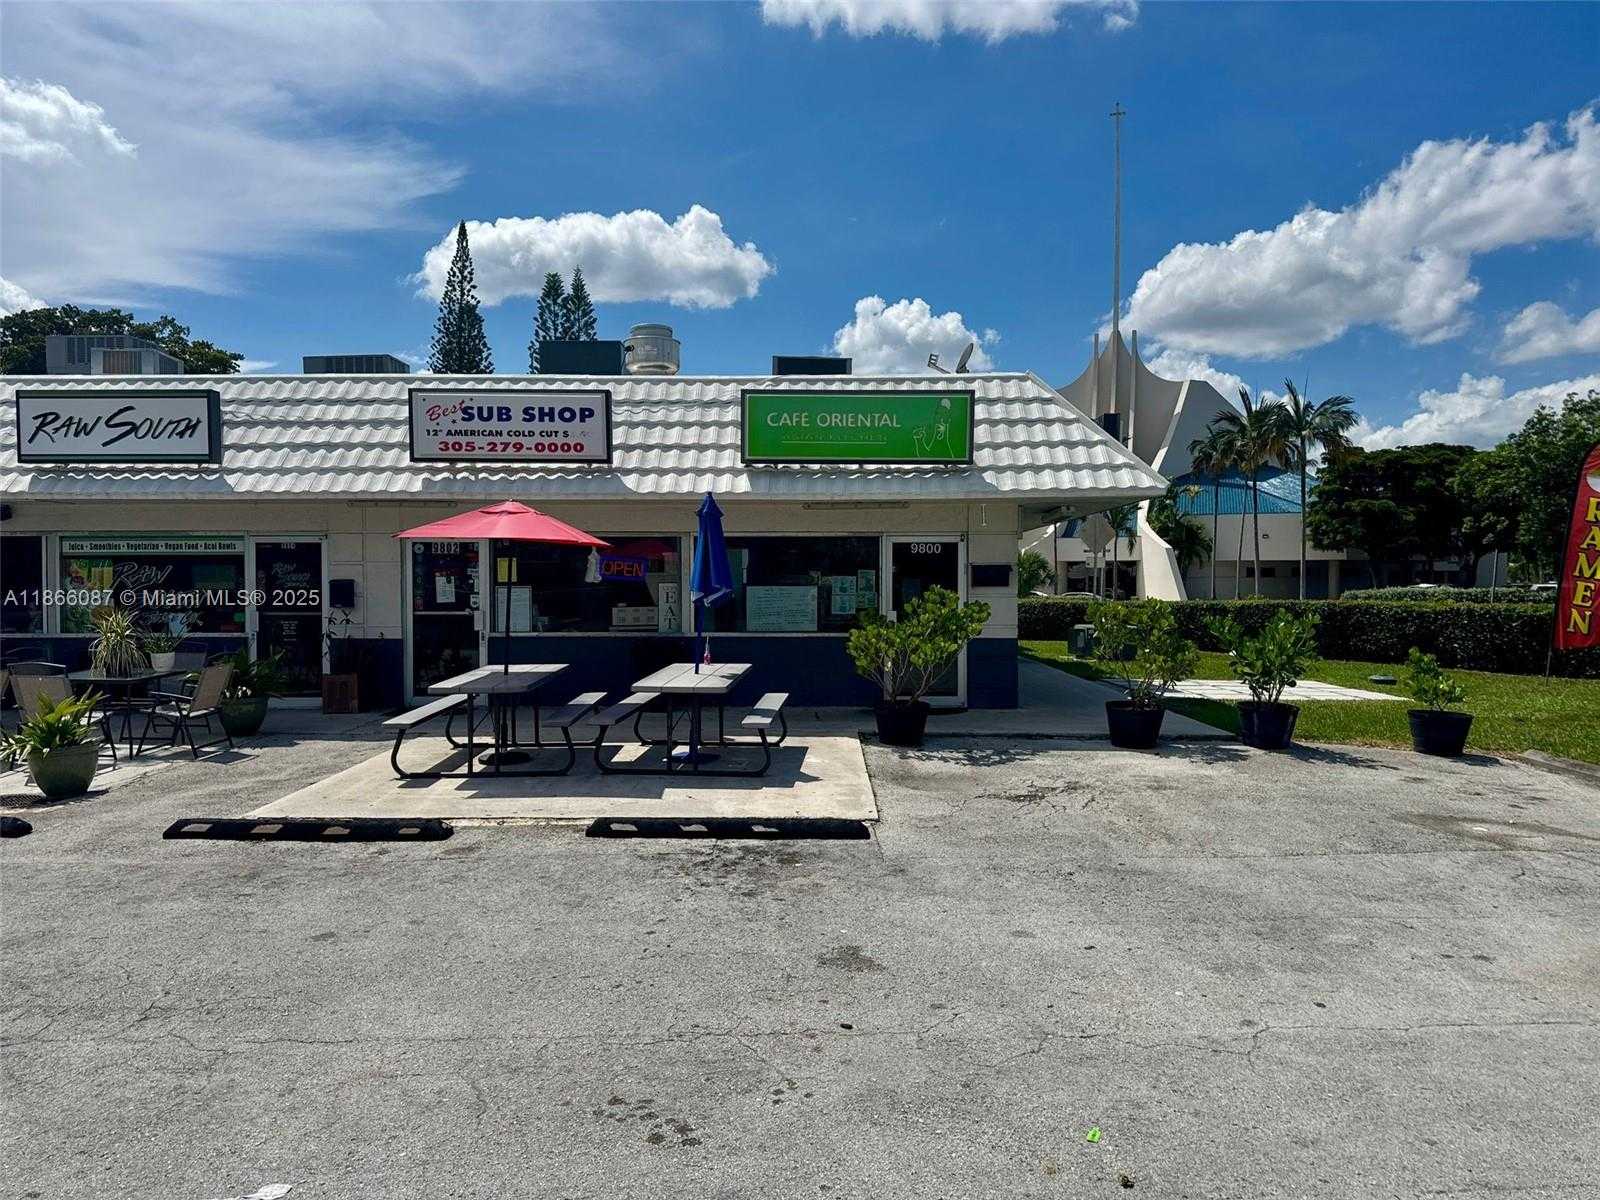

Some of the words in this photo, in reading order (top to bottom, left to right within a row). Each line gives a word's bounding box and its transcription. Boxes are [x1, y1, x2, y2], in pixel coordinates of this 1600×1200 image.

[426, 400, 465, 421] Best
[461, 406, 513, 422] SUB
[522, 406, 595, 423] SHOP
[817, 412, 902, 427] ORIENTAL
[446, 429, 503, 437] AMERICAN
[507, 430, 535, 438] COLD
[539, 430, 559, 438] CUT
[438, 441, 585, 453] 305-279-0000
[432, 543, 459, 554] 9802
[911, 543, 941, 554] 9800
[602, 560, 643, 577] OPEN
[1567, 497, 1600, 635] RAMEN
[663, 591, 678, 630] EAT
